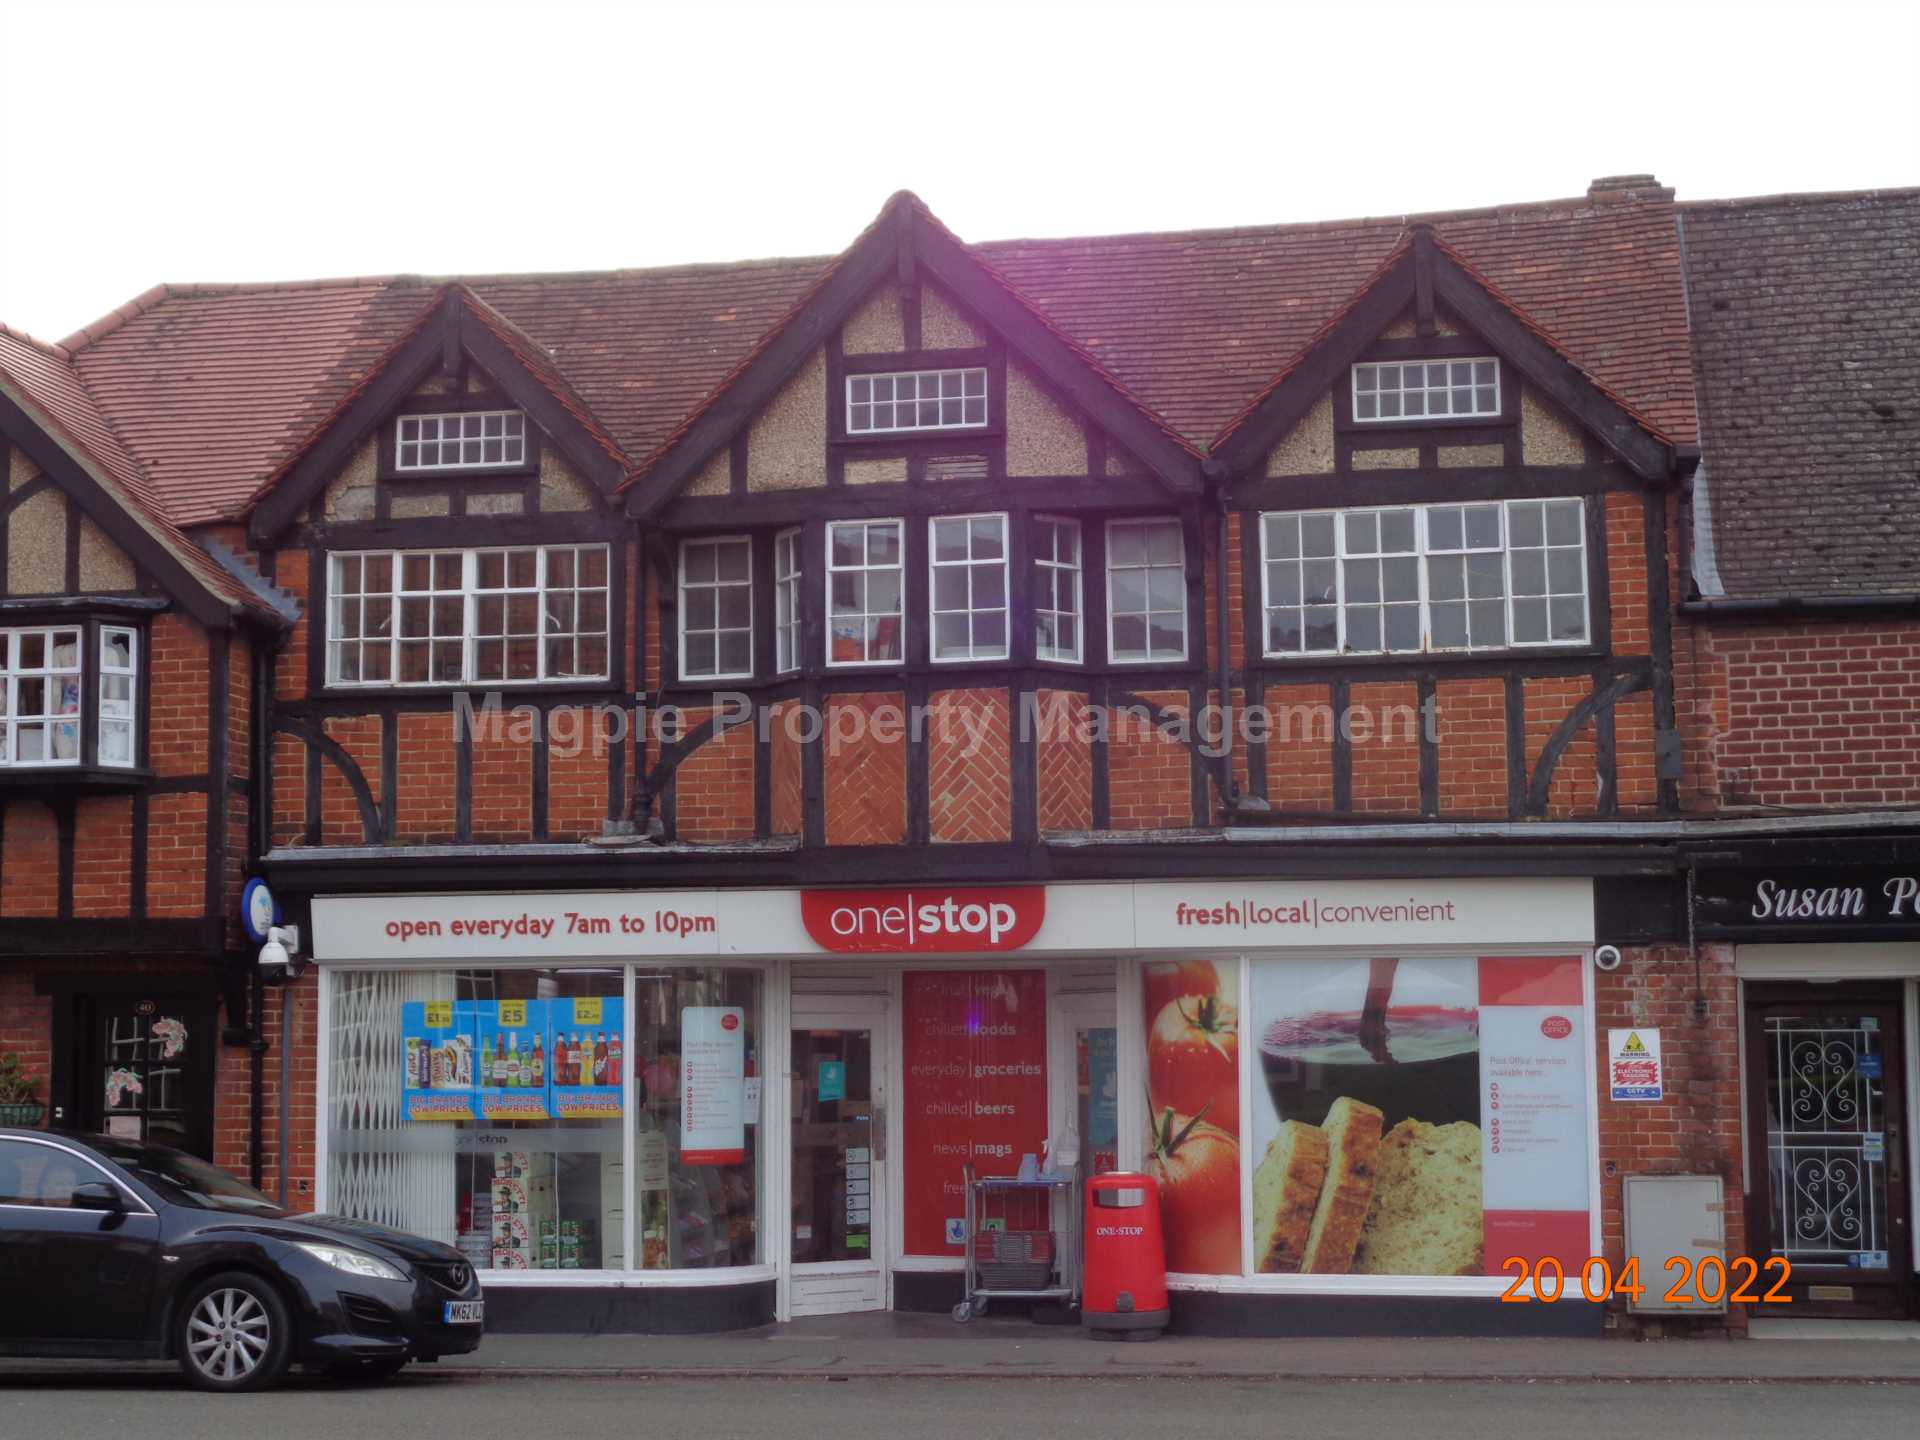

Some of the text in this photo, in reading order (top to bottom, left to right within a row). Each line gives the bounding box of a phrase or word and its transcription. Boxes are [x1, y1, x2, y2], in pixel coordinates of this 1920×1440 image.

[1751, 879, 1864, 918] Susan
[385, 910, 716, 942] open everyday 7am to 10pm
[502, 1010, 523, 1023] £5
[911, 1061, 1041, 1080] everyday groceries
[926, 1100, 1016, 1115] chilled beers
[933, 1142, 1013, 1157] news mags
